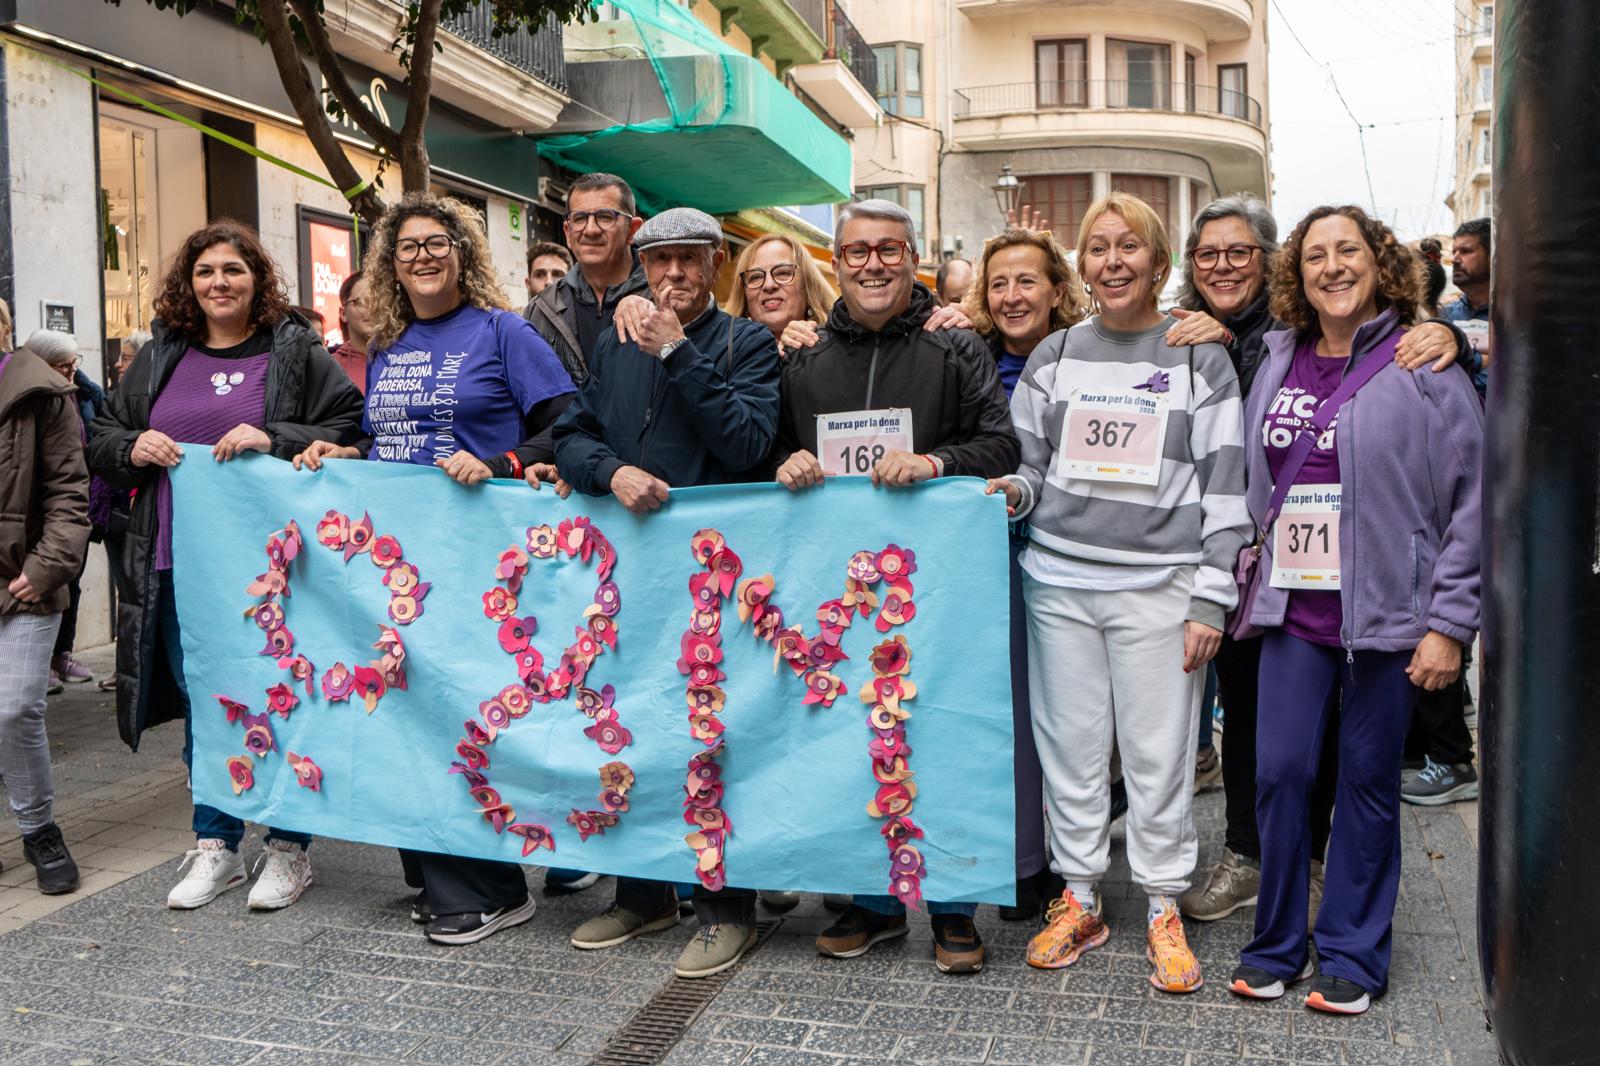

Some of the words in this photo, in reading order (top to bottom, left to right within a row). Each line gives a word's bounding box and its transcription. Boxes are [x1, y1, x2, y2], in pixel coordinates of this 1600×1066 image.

[406, 364, 432, 378] DONA
[435, 351, 468, 378] MARÇ
[374, 379, 425, 392] PODEROSA,
[435, 382, 457, 395] DE
[411, 391, 437, 406] ELLA
[1080, 394, 1107, 403] Marxa
[1107, 396, 1123, 405] per
[1124, 395, 1133, 403] la
[1134, 396, 1157, 408] dona
[1139, 407, 1156, 415] 2025
[828, 421, 853, 431] Marxa
[854, 419, 869, 431] per
[869, 418, 878, 428] la
[878, 417, 900, 427] dona
[1276, 417, 1302, 427] amb
[1085, 419, 1137, 448] 367
[408, 435, 428, 448] TOT
[840, 444, 885, 474] 168
[1284, 494, 1299, 504] arxa
[1300, 495, 1313, 506] per
[1314, 493, 1323, 503] la
[1288, 523, 1329, 554] 371
